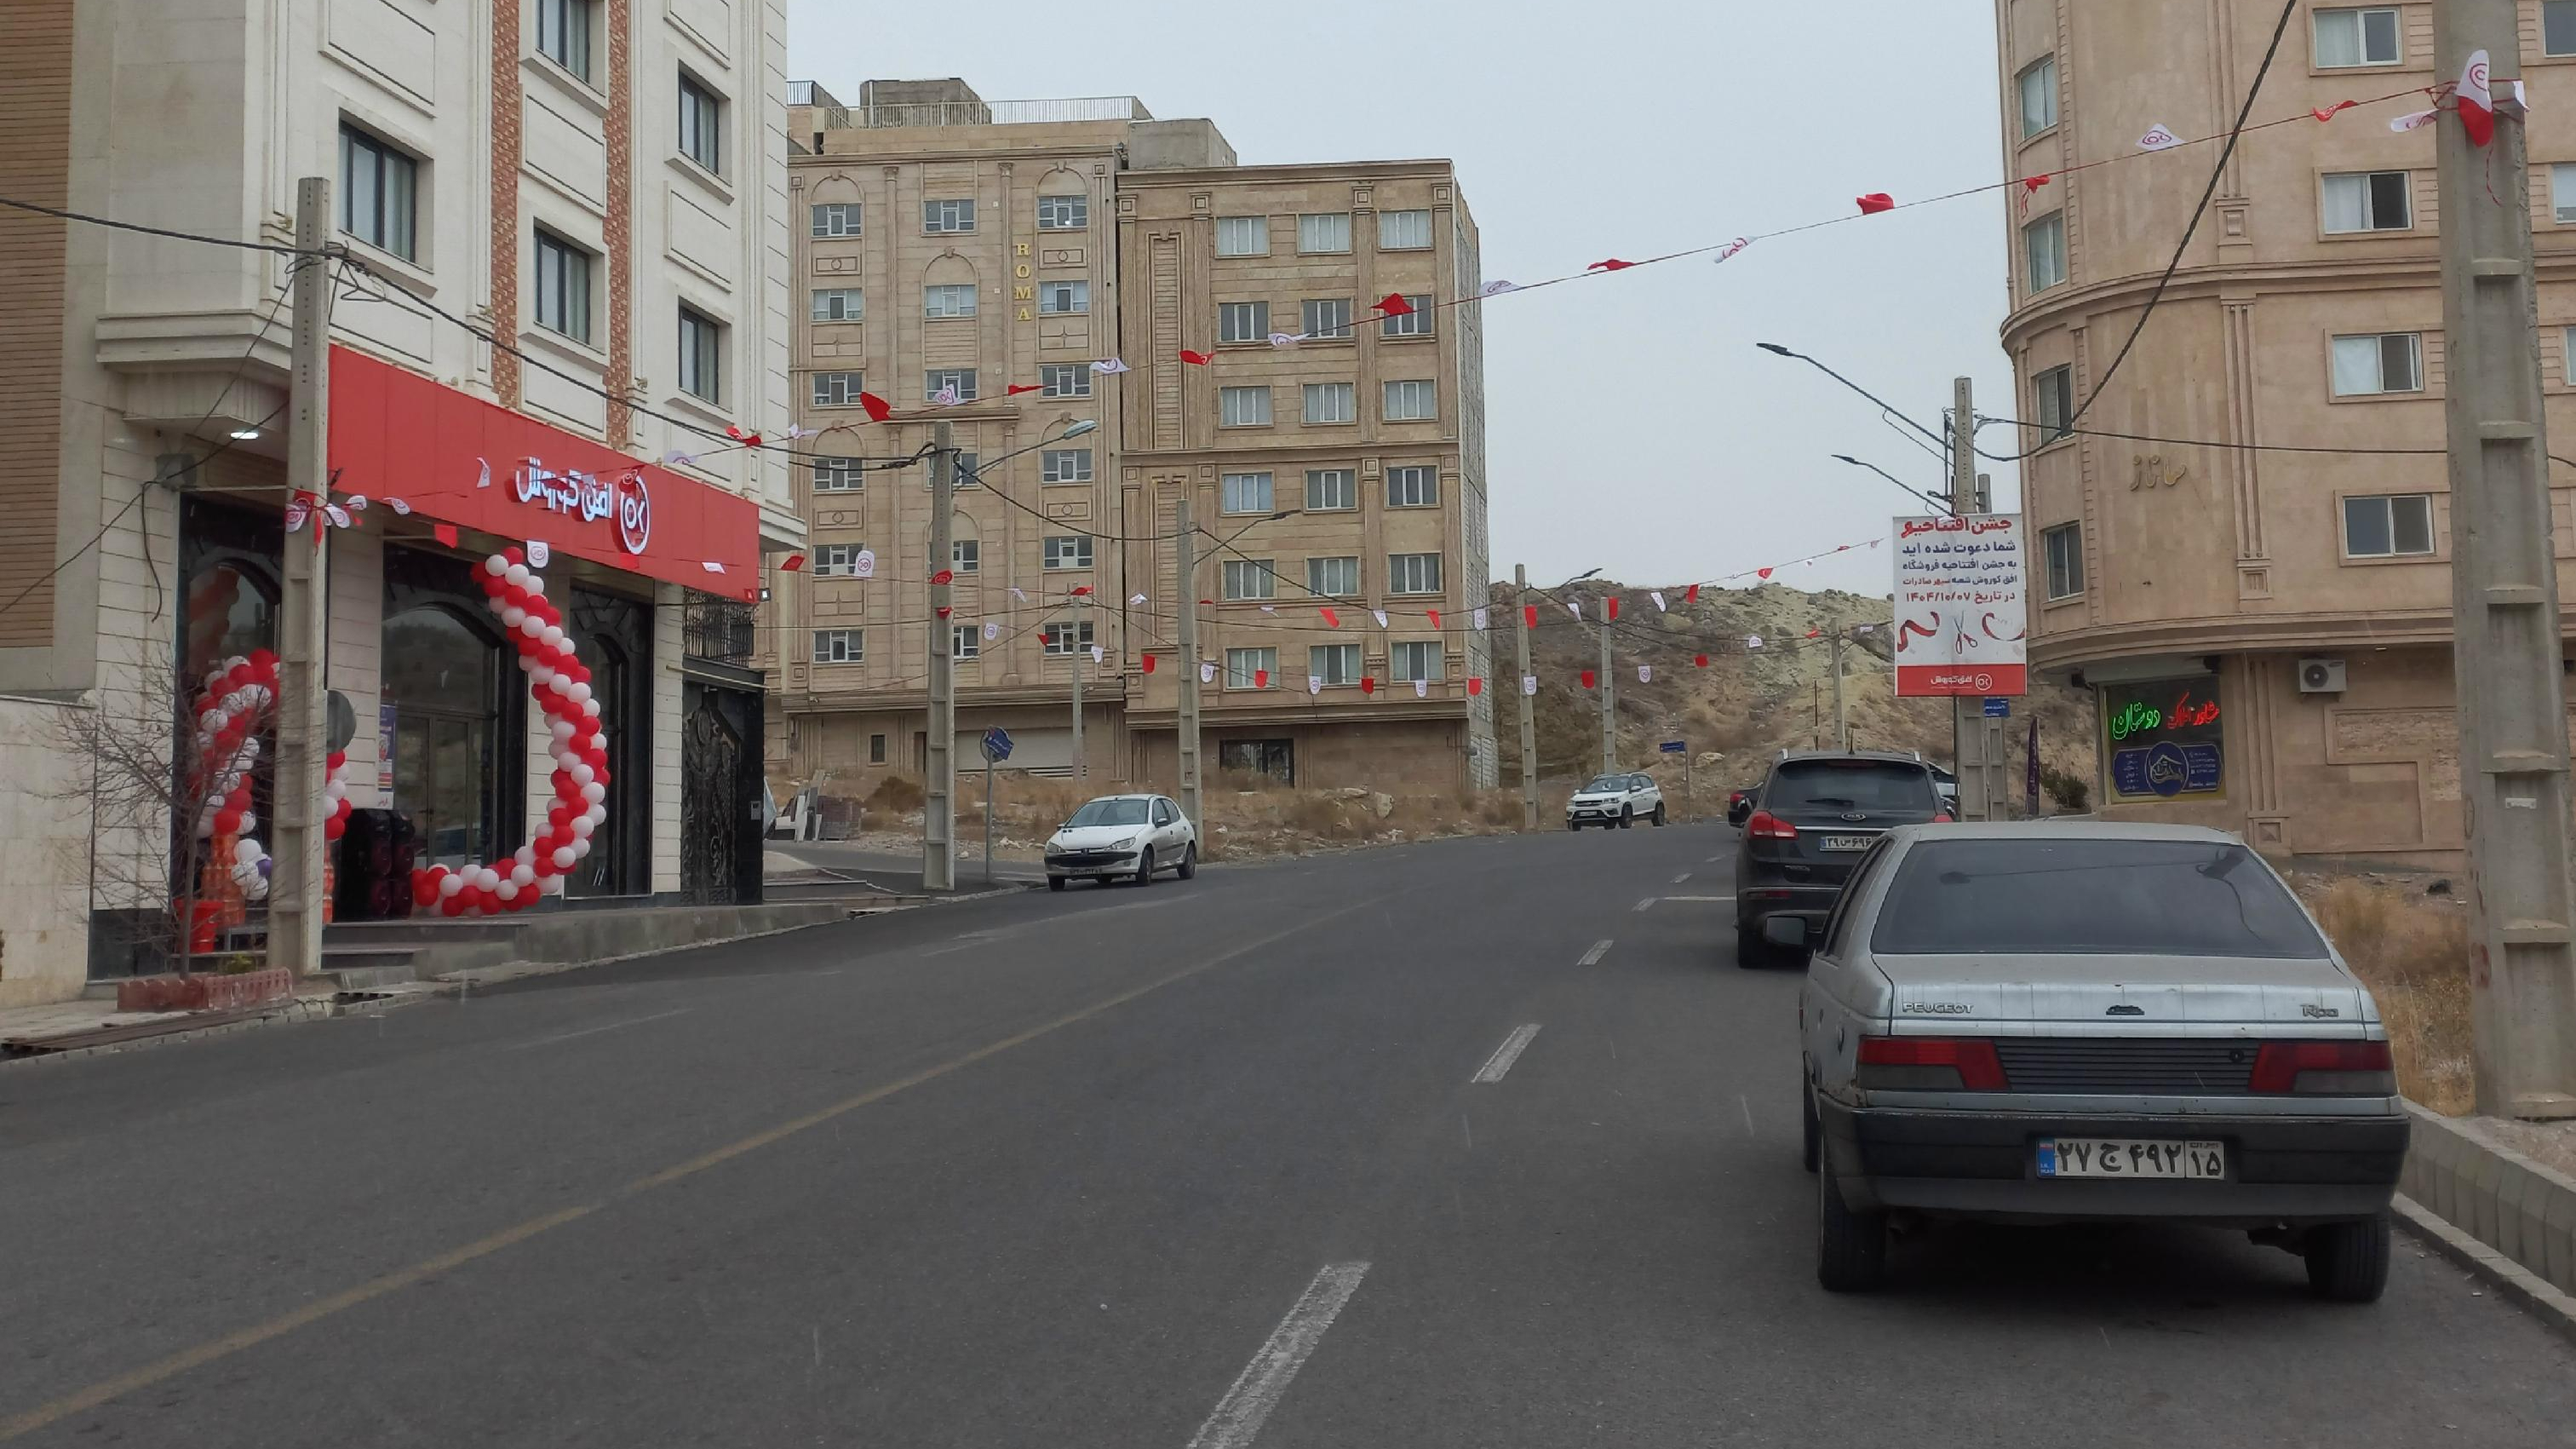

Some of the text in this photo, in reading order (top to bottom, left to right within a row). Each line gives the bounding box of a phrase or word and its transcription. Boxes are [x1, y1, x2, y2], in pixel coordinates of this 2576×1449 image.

[1971, 515, 2012, 535] جشن
[1902, 540, 2016, 557] شما دعوت شده اید
[1902, 559, 2017, 572] به جشن افتتاحیه فروشگاه
[1971, 575, 2001, 585] کوروش
[2002, 574, 2017, 585] افق
[1906, 590, 2016, 604] در تاریخ ۱۴۰۴/۱۰/۰۷
[2112, 701, 2161, 740] دوستان
[1902, 1003, 1975, 1014] PEUGEOT
[2190, 1150, 2222, 1176] ۱۵
